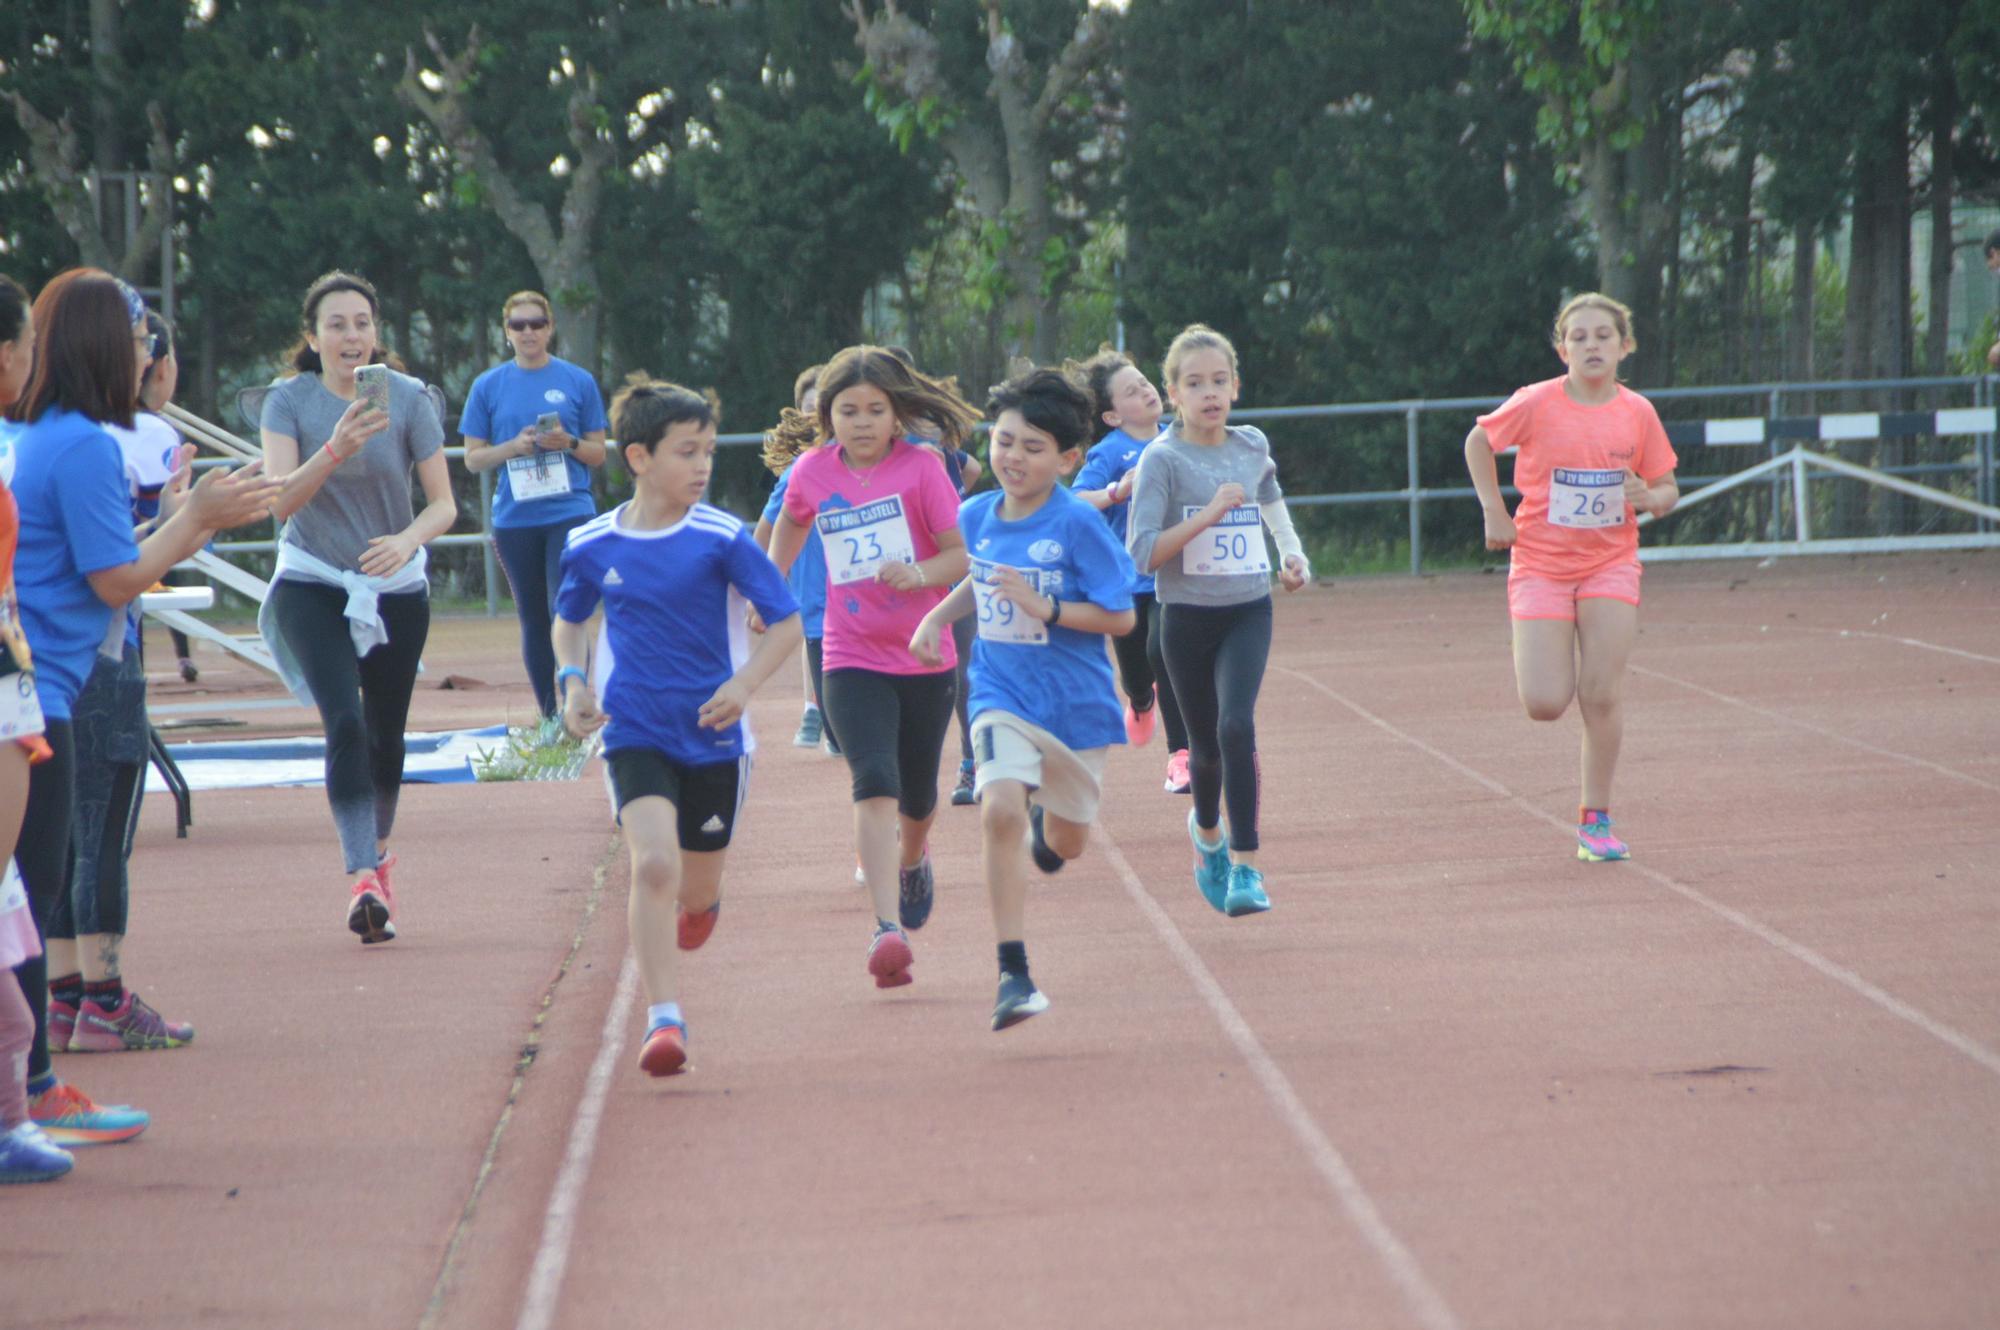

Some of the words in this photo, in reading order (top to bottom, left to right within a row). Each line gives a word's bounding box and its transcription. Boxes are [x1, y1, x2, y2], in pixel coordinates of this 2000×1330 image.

[860, 502, 898, 523] CASTELL
[1234, 509, 1259, 523] CASTELL
[1573, 493, 1605, 516] 26
[843, 532, 882, 565] 23
[1213, 533, 1247, 561] 50
[979, 592, 1014, 626] 39
